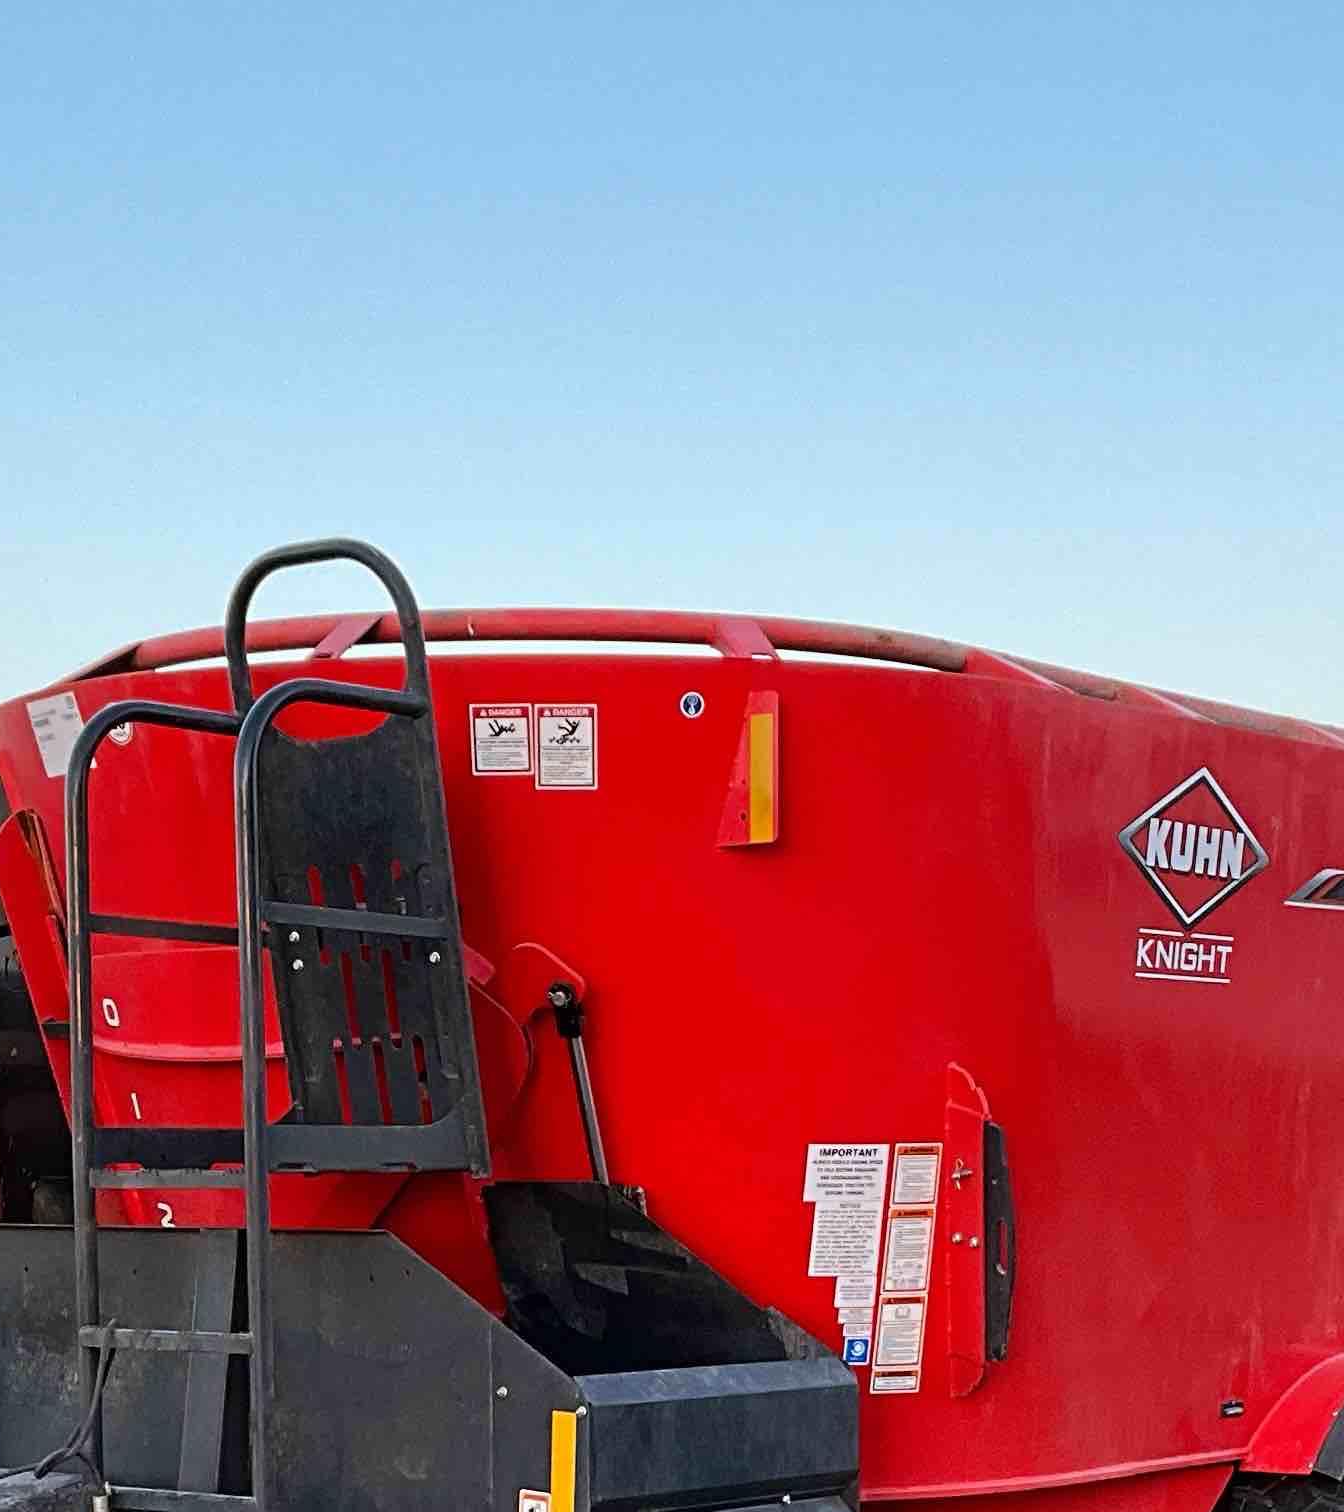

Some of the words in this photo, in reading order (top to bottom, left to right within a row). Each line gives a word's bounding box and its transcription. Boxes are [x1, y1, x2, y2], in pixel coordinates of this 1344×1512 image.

[488, 708, 522, 716] DANGER
[552, 708, 589, 716] DANGER
[1145, 817, 1245, 880] KUHN
[1136, 938, 1233, 974] KNIGHT
[819, 1148, 879, 1157] IMPORTANT
[156, 1202, 176, 1228] 2
